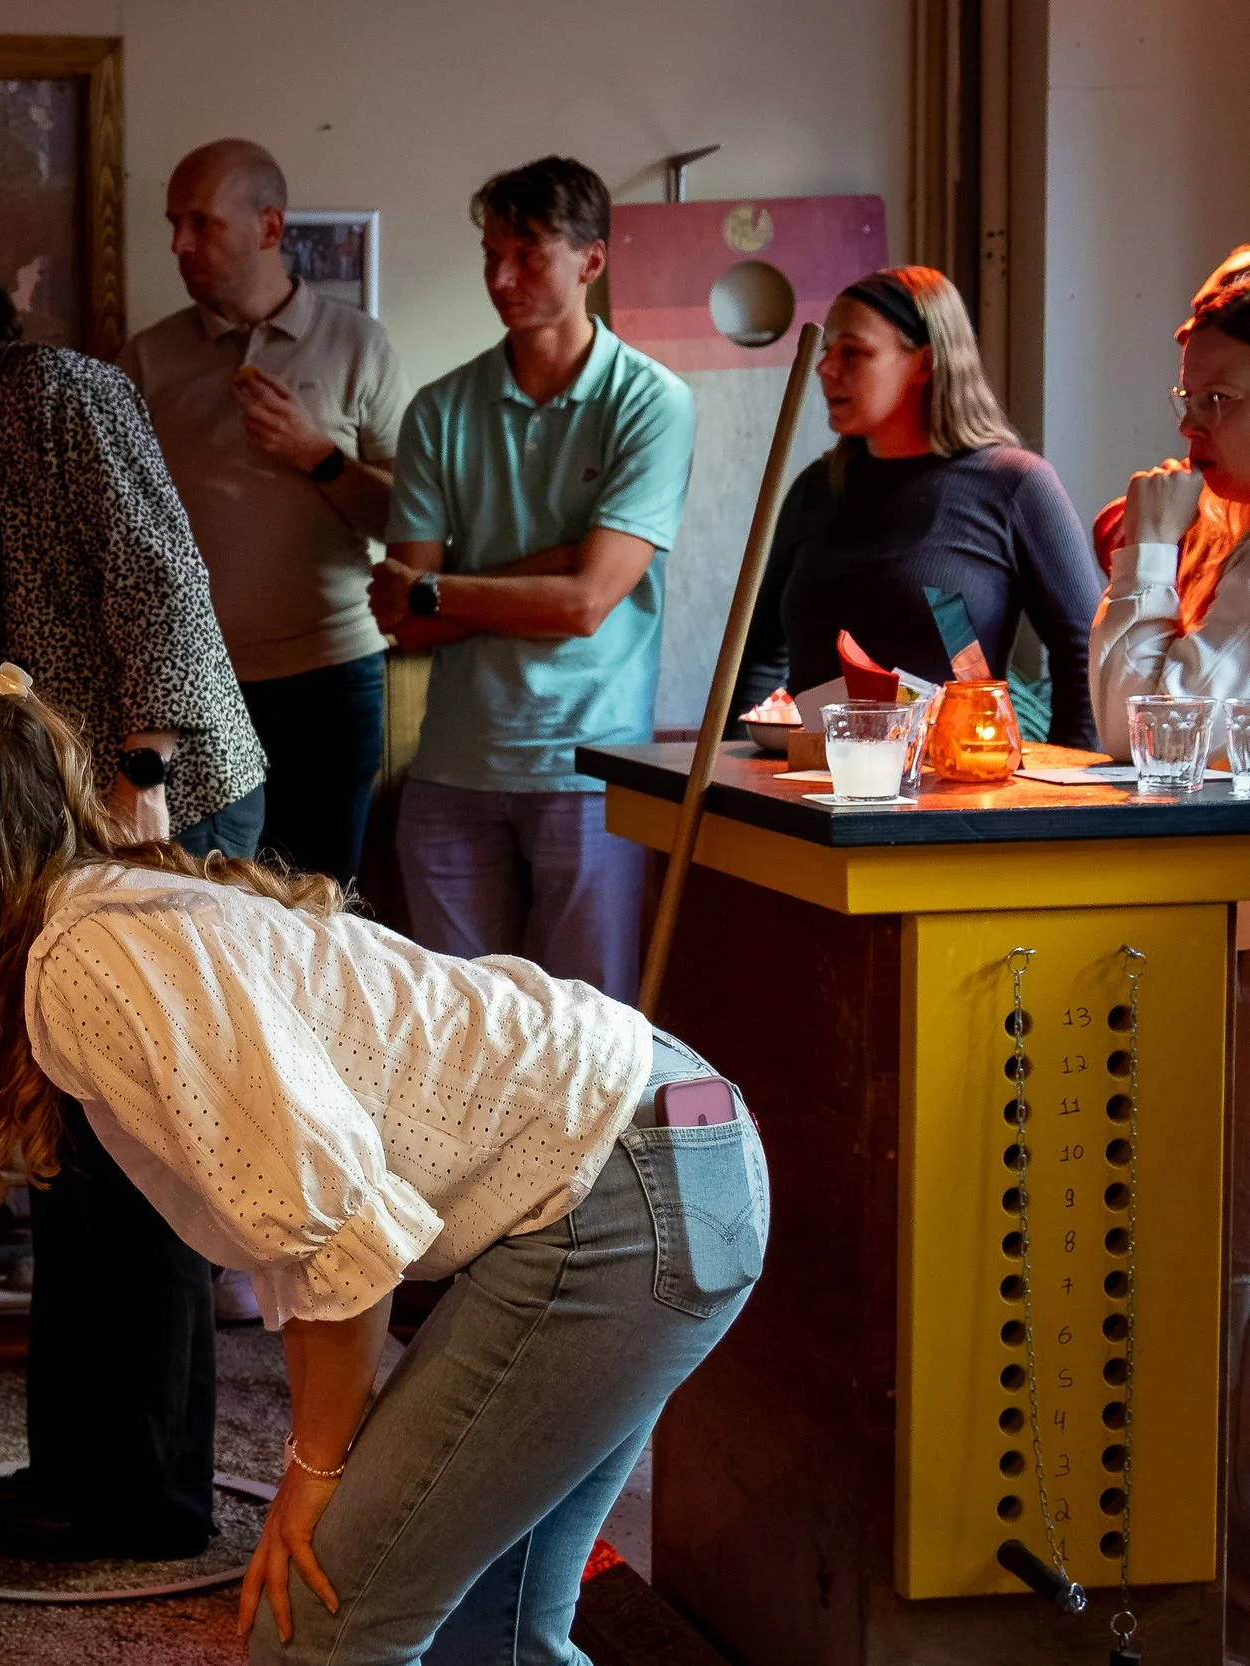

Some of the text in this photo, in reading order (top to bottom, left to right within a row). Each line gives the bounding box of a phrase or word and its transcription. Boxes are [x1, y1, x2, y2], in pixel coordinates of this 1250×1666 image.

[1062, 1007, 1092, 1028] 13
[1062, 1055, 1088, 1074] 12
[1058, 1098, 1082, 1116] 11
[1059, 1144, 1084, 1162] 10
[1064, 1188, 1075, 1208] 9
[1064, 1230, 1076, 1253] 8
[1061, 1277, 1073, 1296] 7
[1057, 1325, 1072, 1345] 6
[1058, 1368, 1073, 1388] 5
[1053, 1409, 1067, 1434] 4
[1054, 1454, 1070, 1478] 3
[1055, 1498, 1071, 1522] 2
